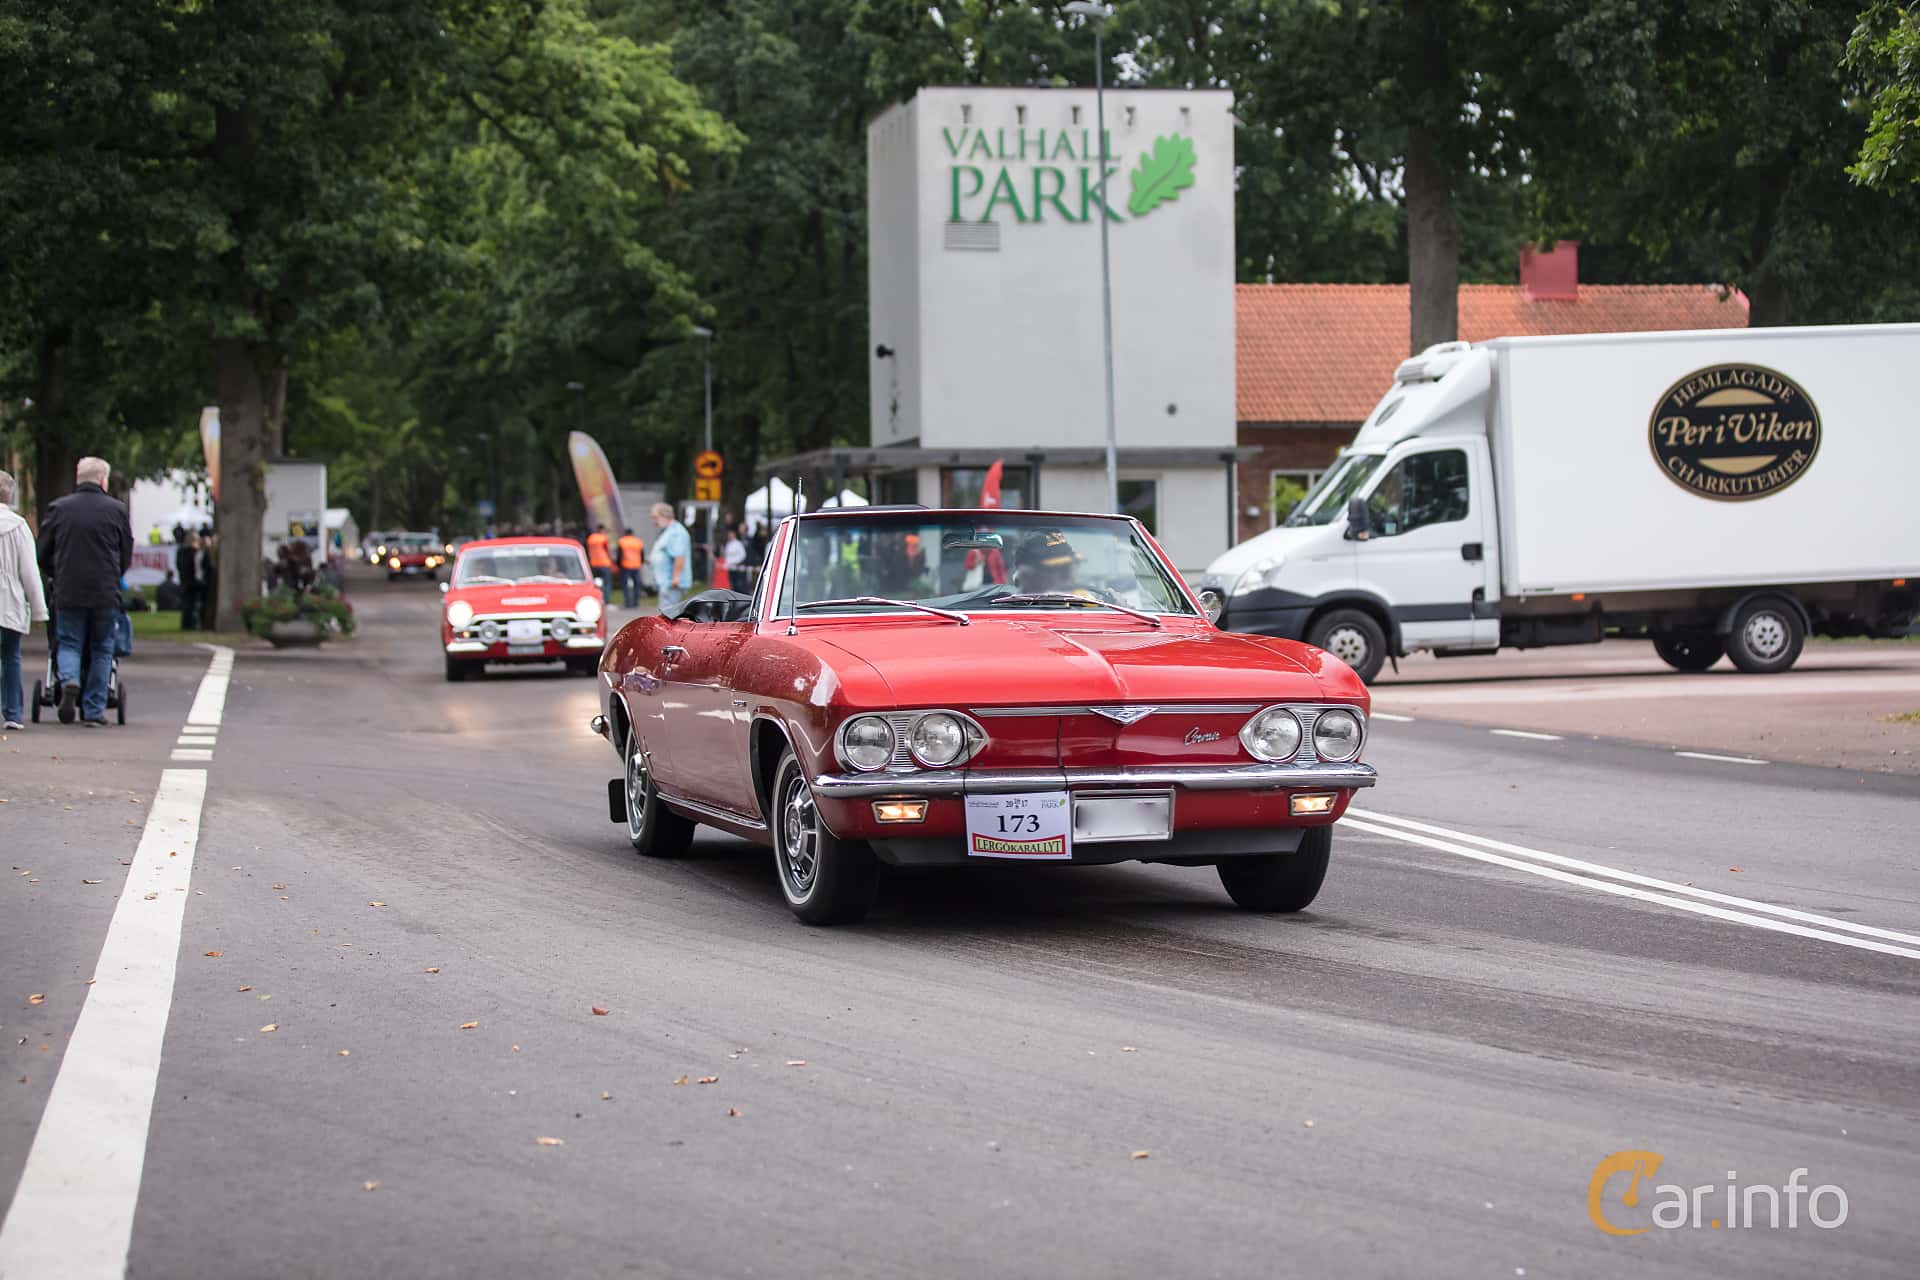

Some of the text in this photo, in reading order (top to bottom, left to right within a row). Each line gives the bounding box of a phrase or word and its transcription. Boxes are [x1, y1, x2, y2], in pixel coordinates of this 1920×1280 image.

[942, 127, 1121, 160] VALHALL
[948, 164, 1128, 223] PARK
[1672, 369, 1795, 408] HEMLAGADE
[1657, 411, 1814, 446] Per i Viken
[1667, 449, 1809, 494] CHARKUTERIER
[996, 814, 1040, 833] 173
